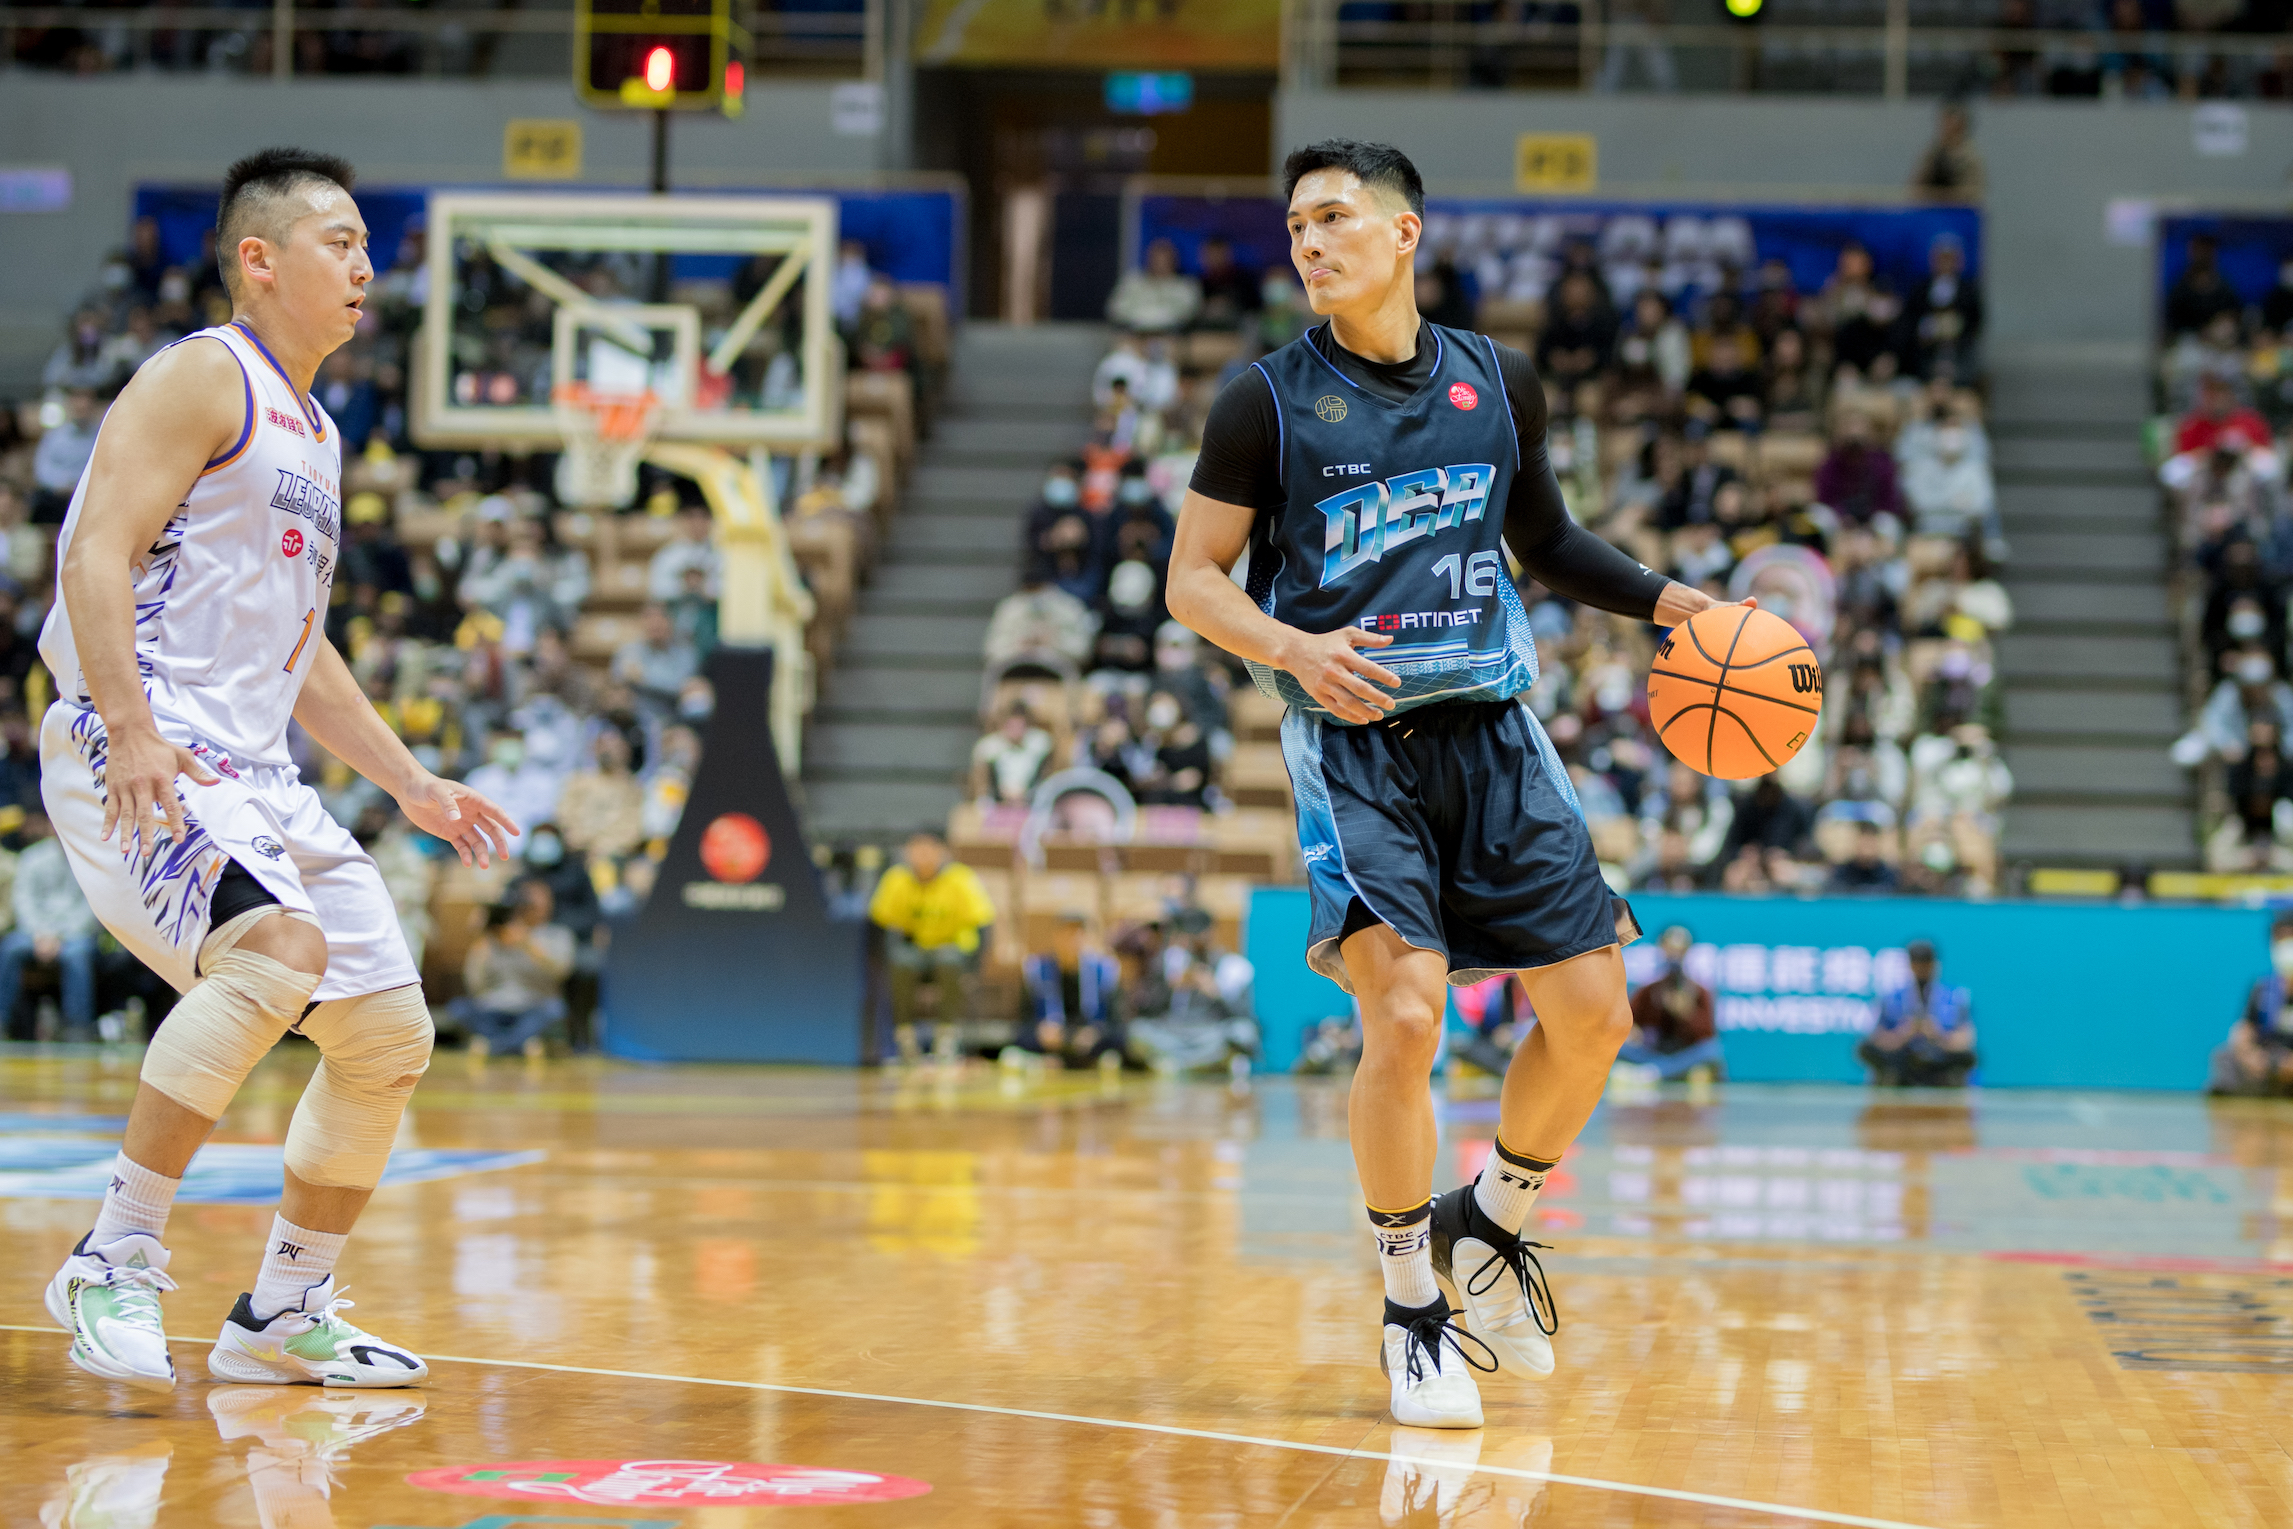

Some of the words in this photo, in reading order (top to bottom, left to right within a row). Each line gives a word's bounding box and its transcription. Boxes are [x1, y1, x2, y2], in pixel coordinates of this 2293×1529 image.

[1322, 463, 1372, 478] CTBC
[1313, 462, 1497, 593] DEA
[1430, 550, 1499, 600] 16
[283, 607, 316, 675] 1
[1360, 608, 1483, 631] FORTINET
